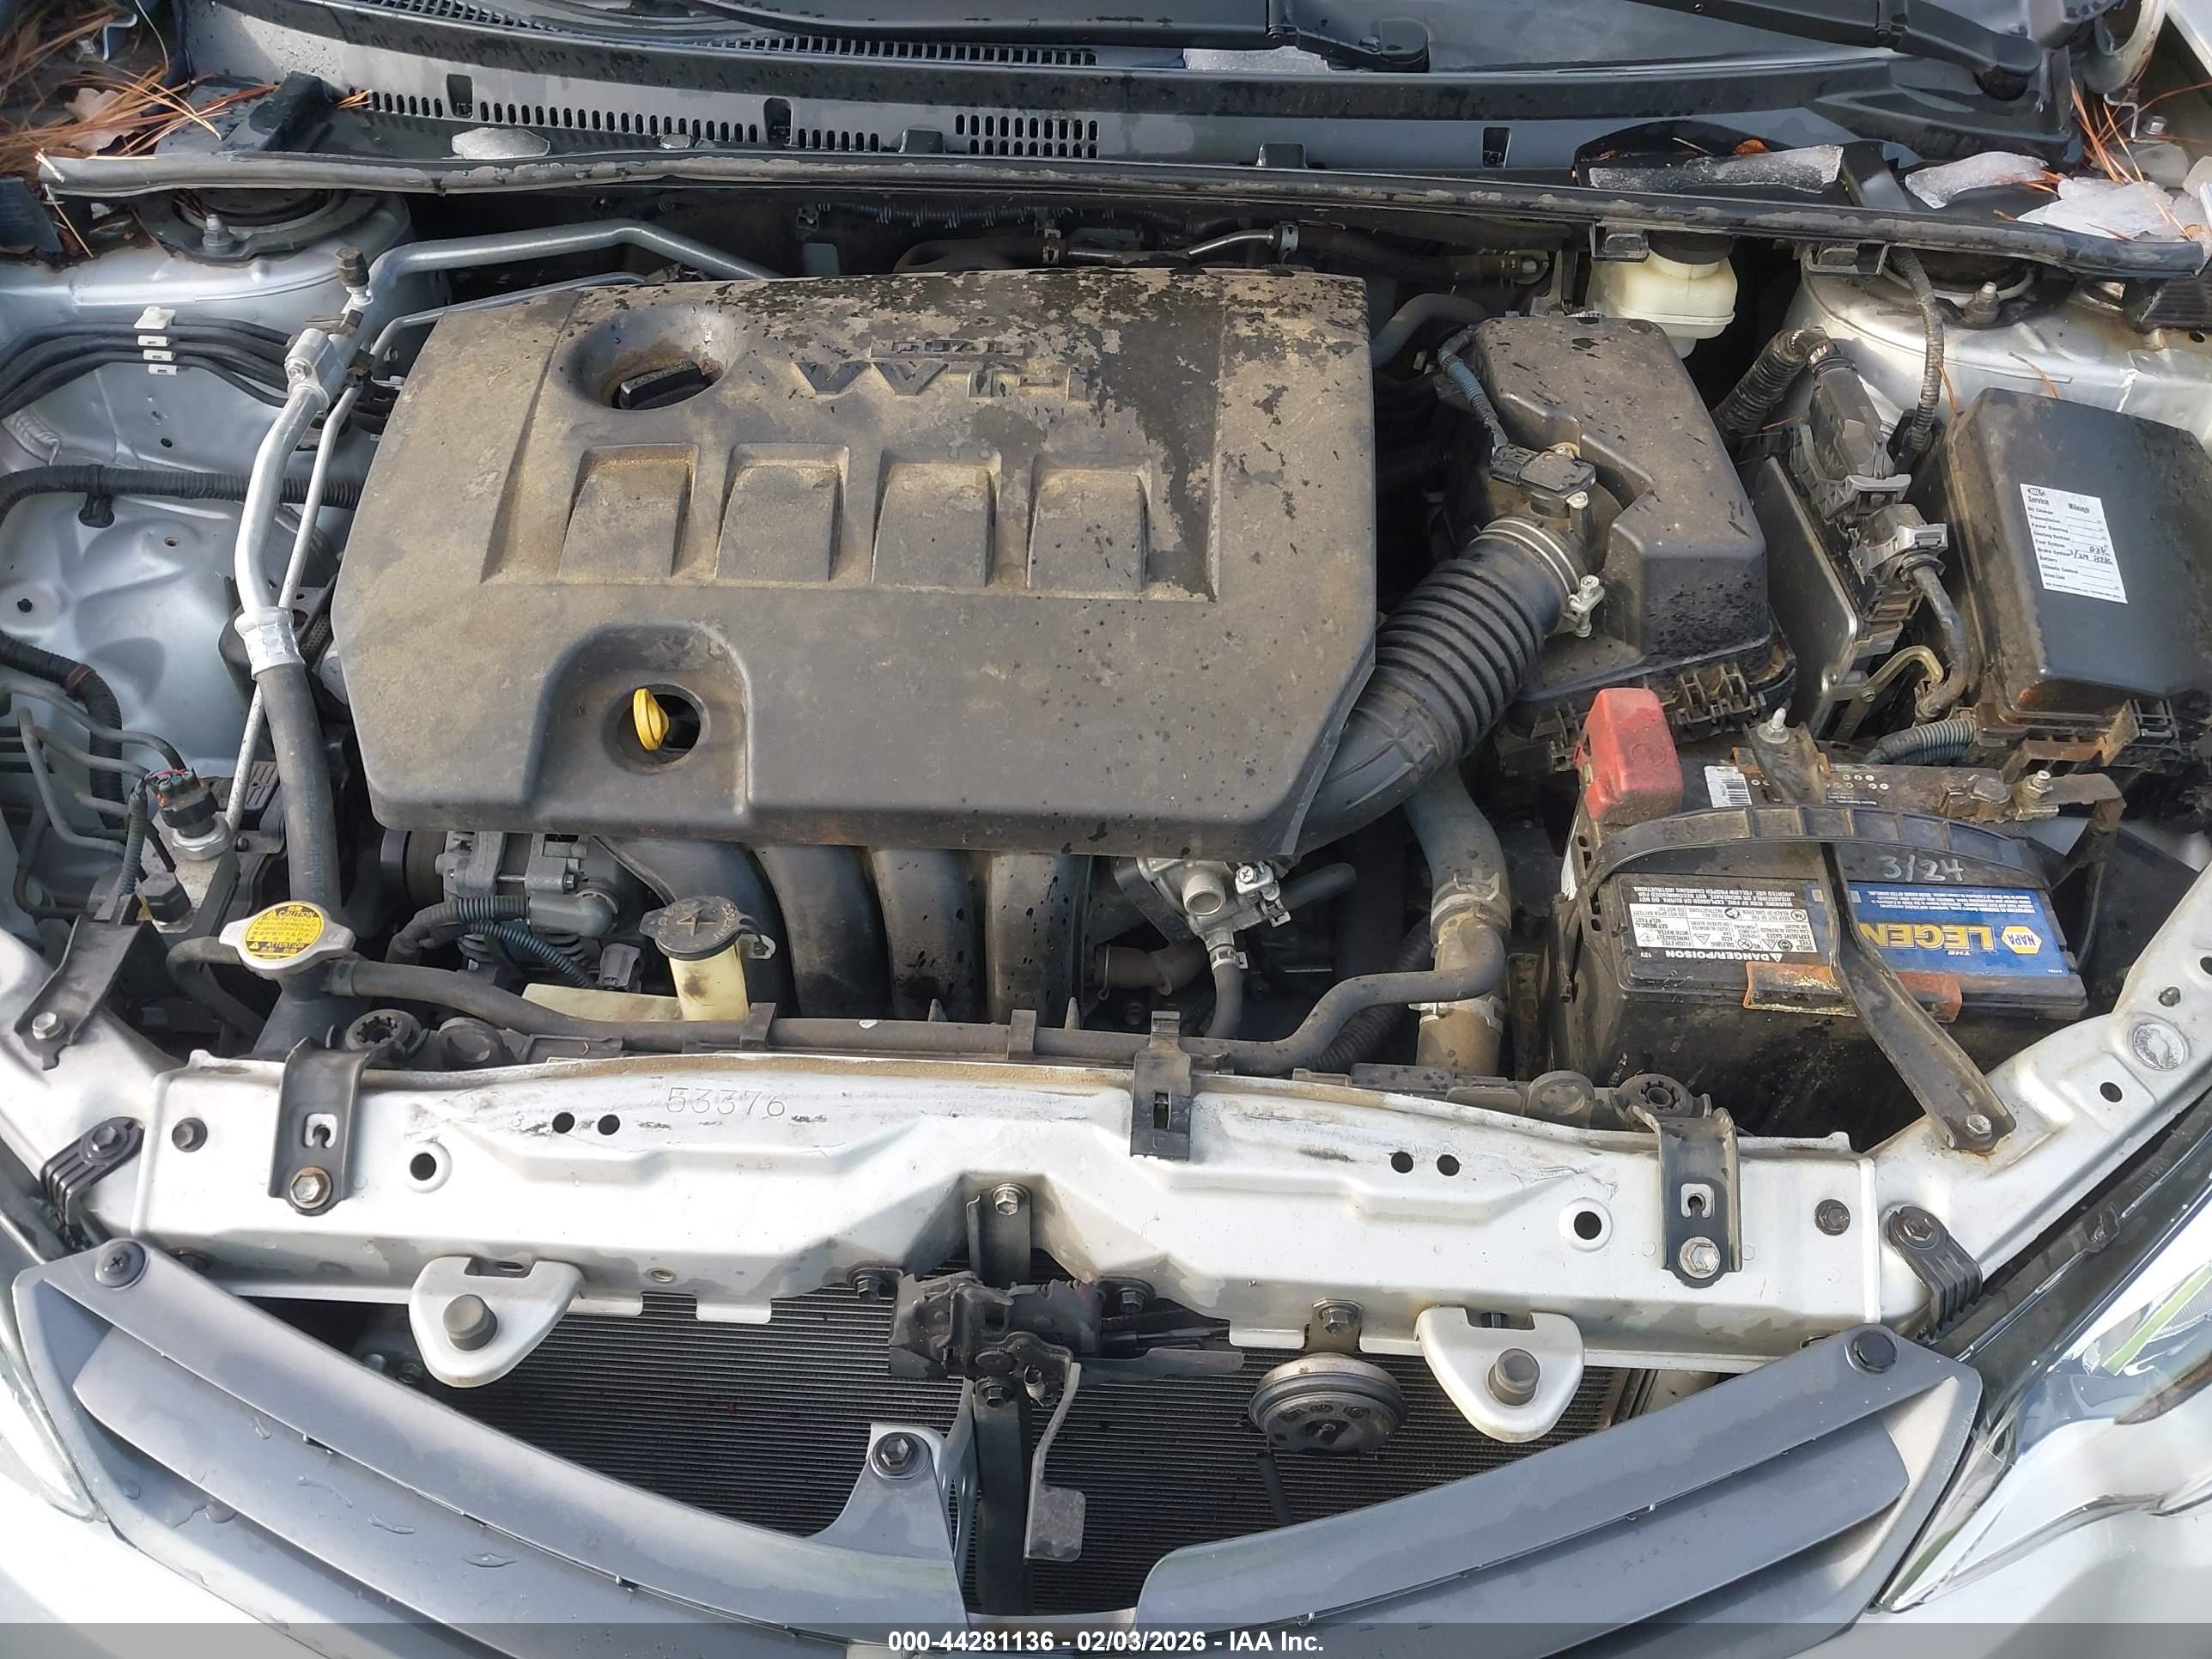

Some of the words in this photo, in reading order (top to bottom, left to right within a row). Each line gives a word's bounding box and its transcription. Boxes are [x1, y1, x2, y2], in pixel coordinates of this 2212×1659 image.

[2028, 495, 2050, 506] Service
[2068, 502, 2090, 514] Mileage
[1881, 854, 1965, 882] 3/24
[1859, 923, 1996, 952] LEGEN
[2007, 933, 2036, 945] NAPA
[1665, 950, 1770, 960] DANGER/POISON
[666, 1087, 786, 1117] 53376
